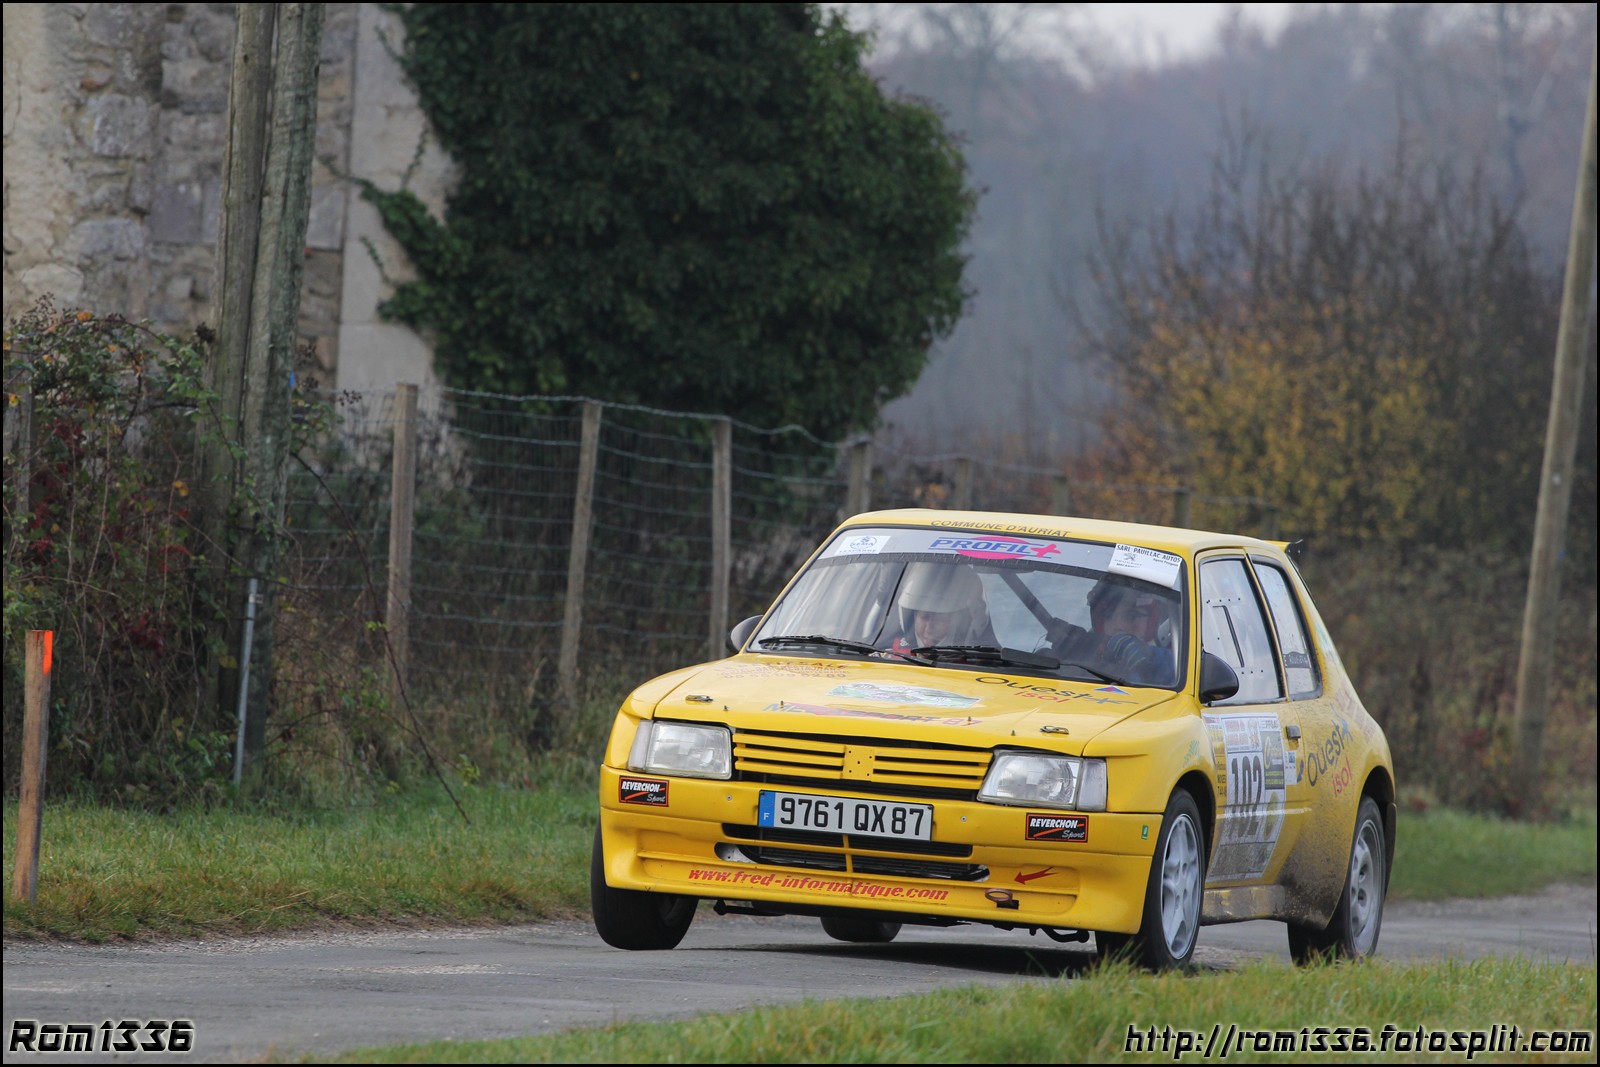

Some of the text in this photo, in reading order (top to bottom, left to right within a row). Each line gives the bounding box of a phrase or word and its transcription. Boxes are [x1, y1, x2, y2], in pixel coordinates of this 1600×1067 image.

[931, 520, 1071, 537] COMMUNE D'AURIAT
[1117, 544, 1181, 563] SARL PAUILLAC AUTOS
[975, 676, 1090, 698] Ouest
[1307, 722, 1345, 787] Ouest
[621, 780, 660, 793] REVERCHON
[646, 793, 666, 803] Sport
[1227, 755, 1262, 837] 102
[763, 812, 771, 821] F
[780, 797, 844, 829] 9761
[1030, 818, 1079, 829] REVERCHON
[1061, 830, 1085, 840] Sport
[688, 869, 949, 901] www.fred-informatique.com
